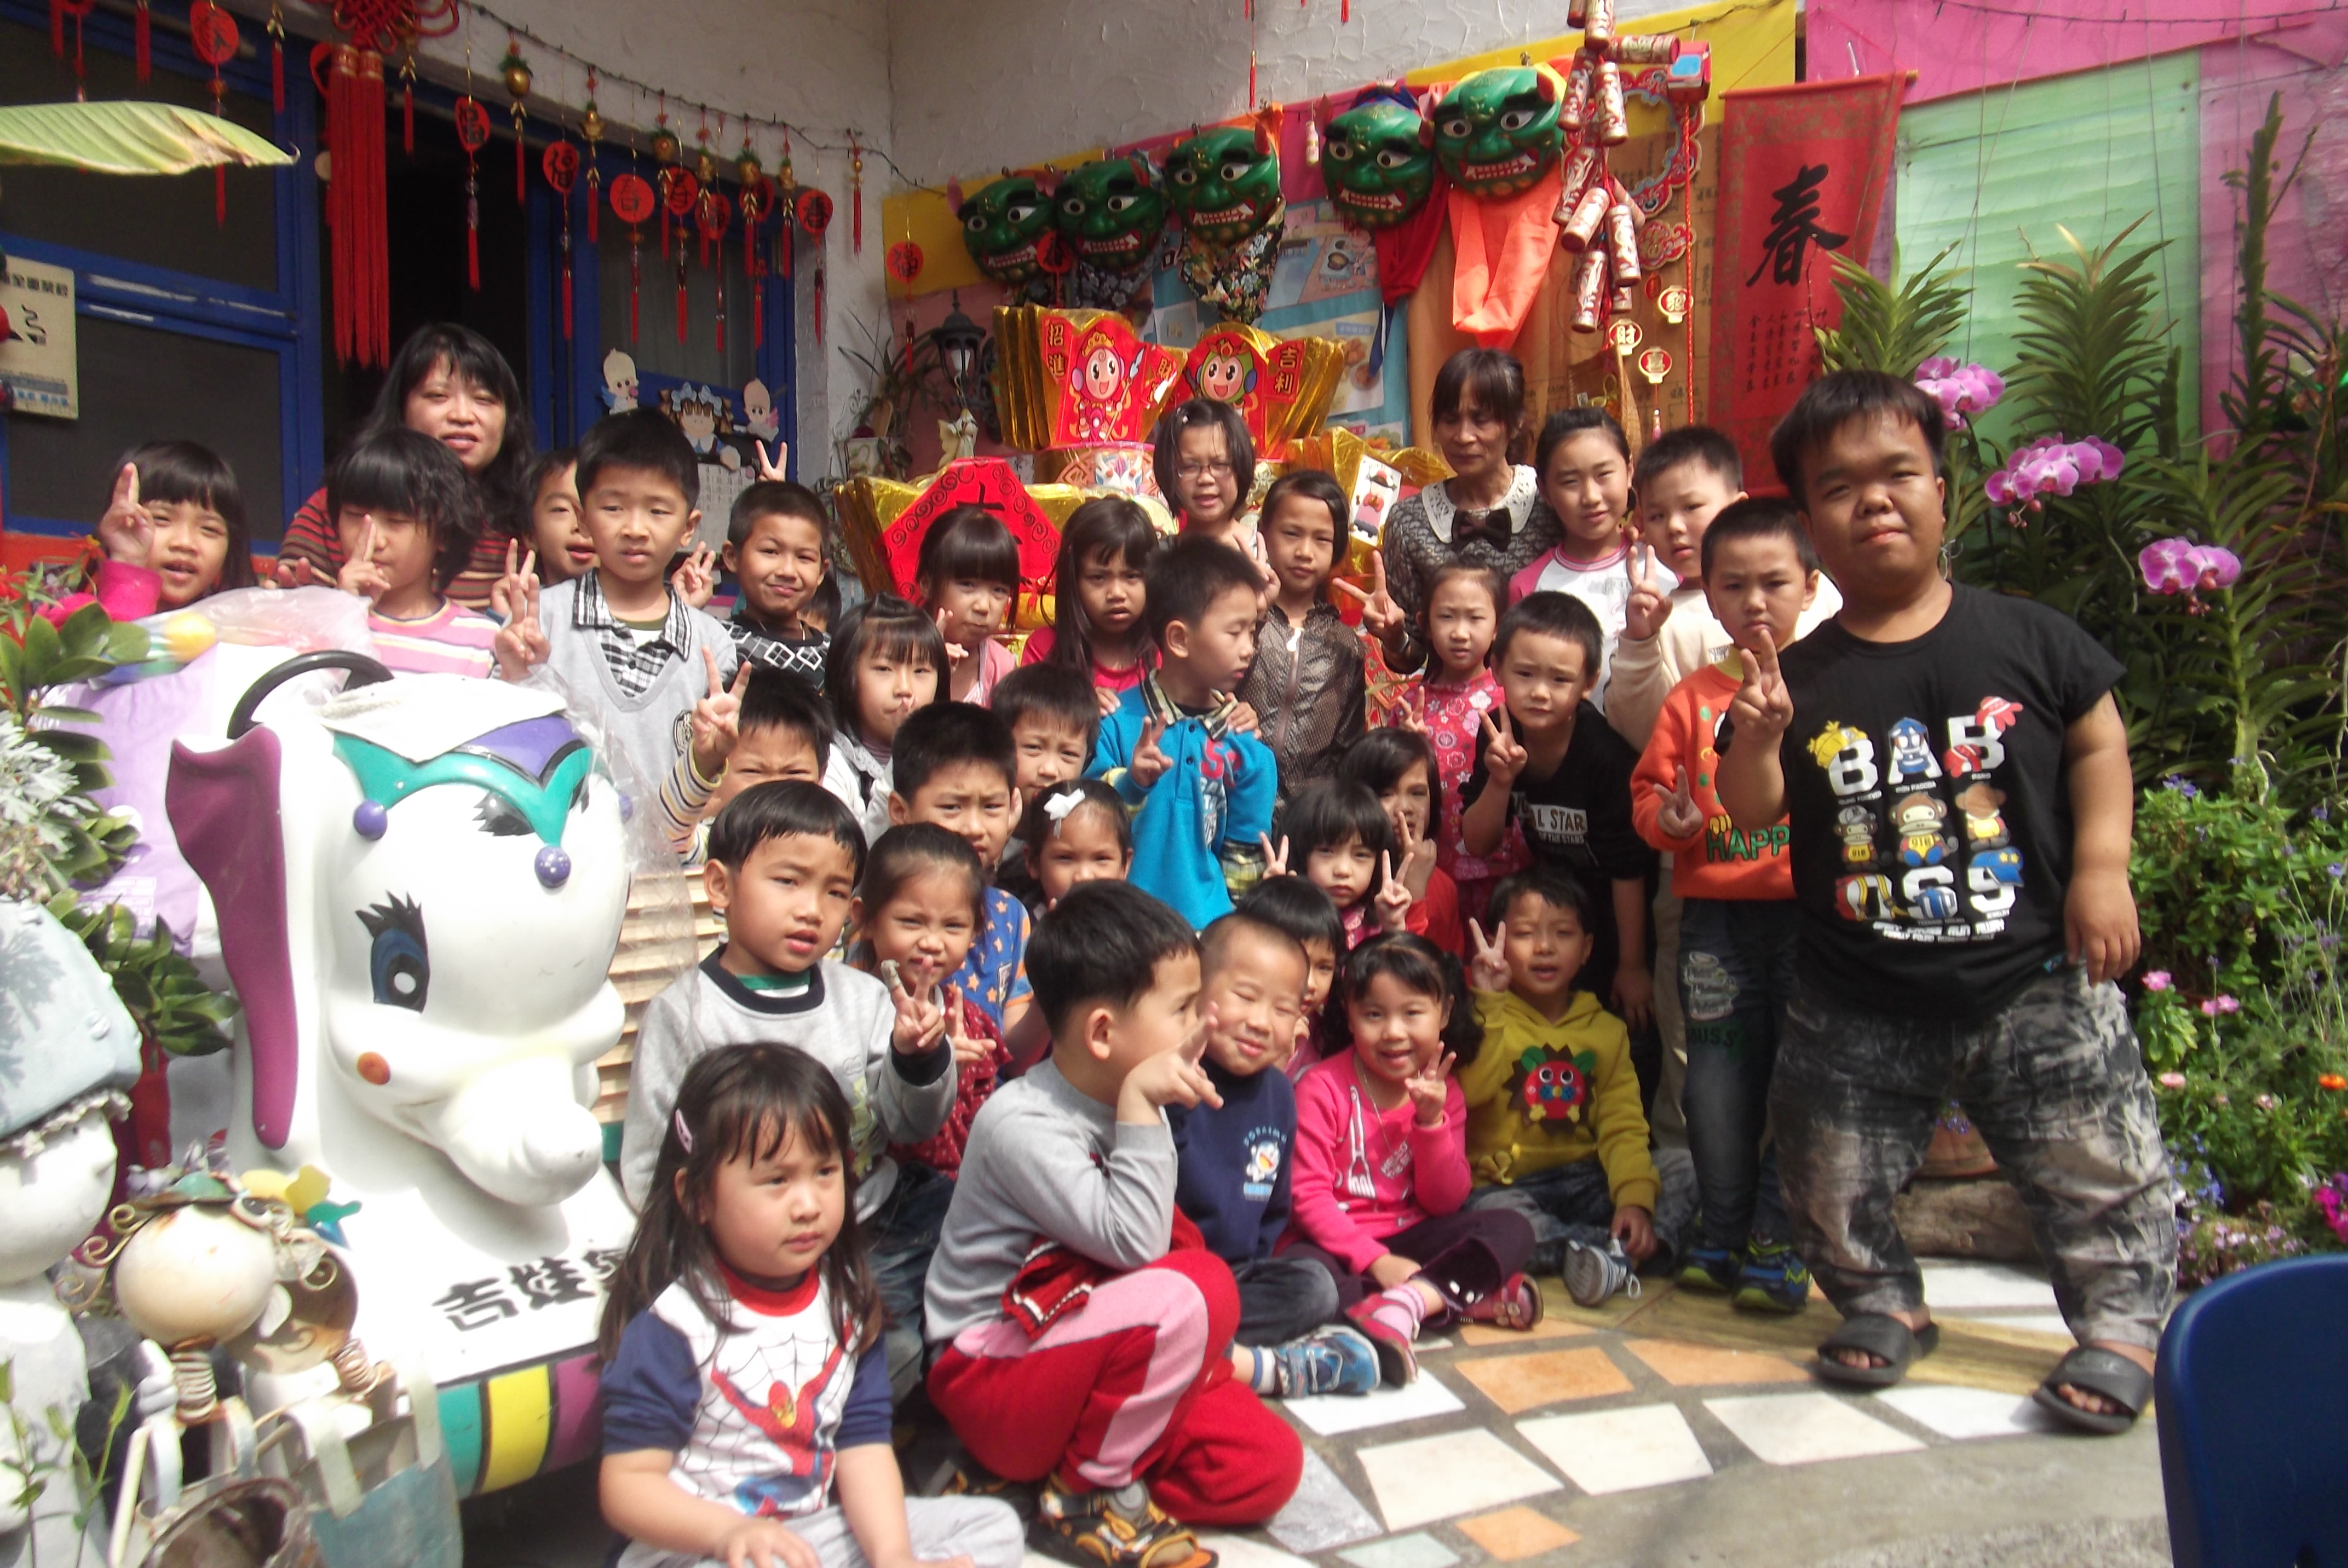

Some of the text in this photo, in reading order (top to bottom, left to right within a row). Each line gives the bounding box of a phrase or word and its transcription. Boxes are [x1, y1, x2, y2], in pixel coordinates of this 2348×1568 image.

[1746, 164, 1850, 287] 春
[893, 244, 918, 279] 福
[1046, 321, 1066, 379] 招進
[1616, 324, 1637, 345] 財
[1273, 345, 1299, 395] 吉利
[1550, 809, 1587, 832] STAR
[1706, 824, 1791, 862] HAPP
